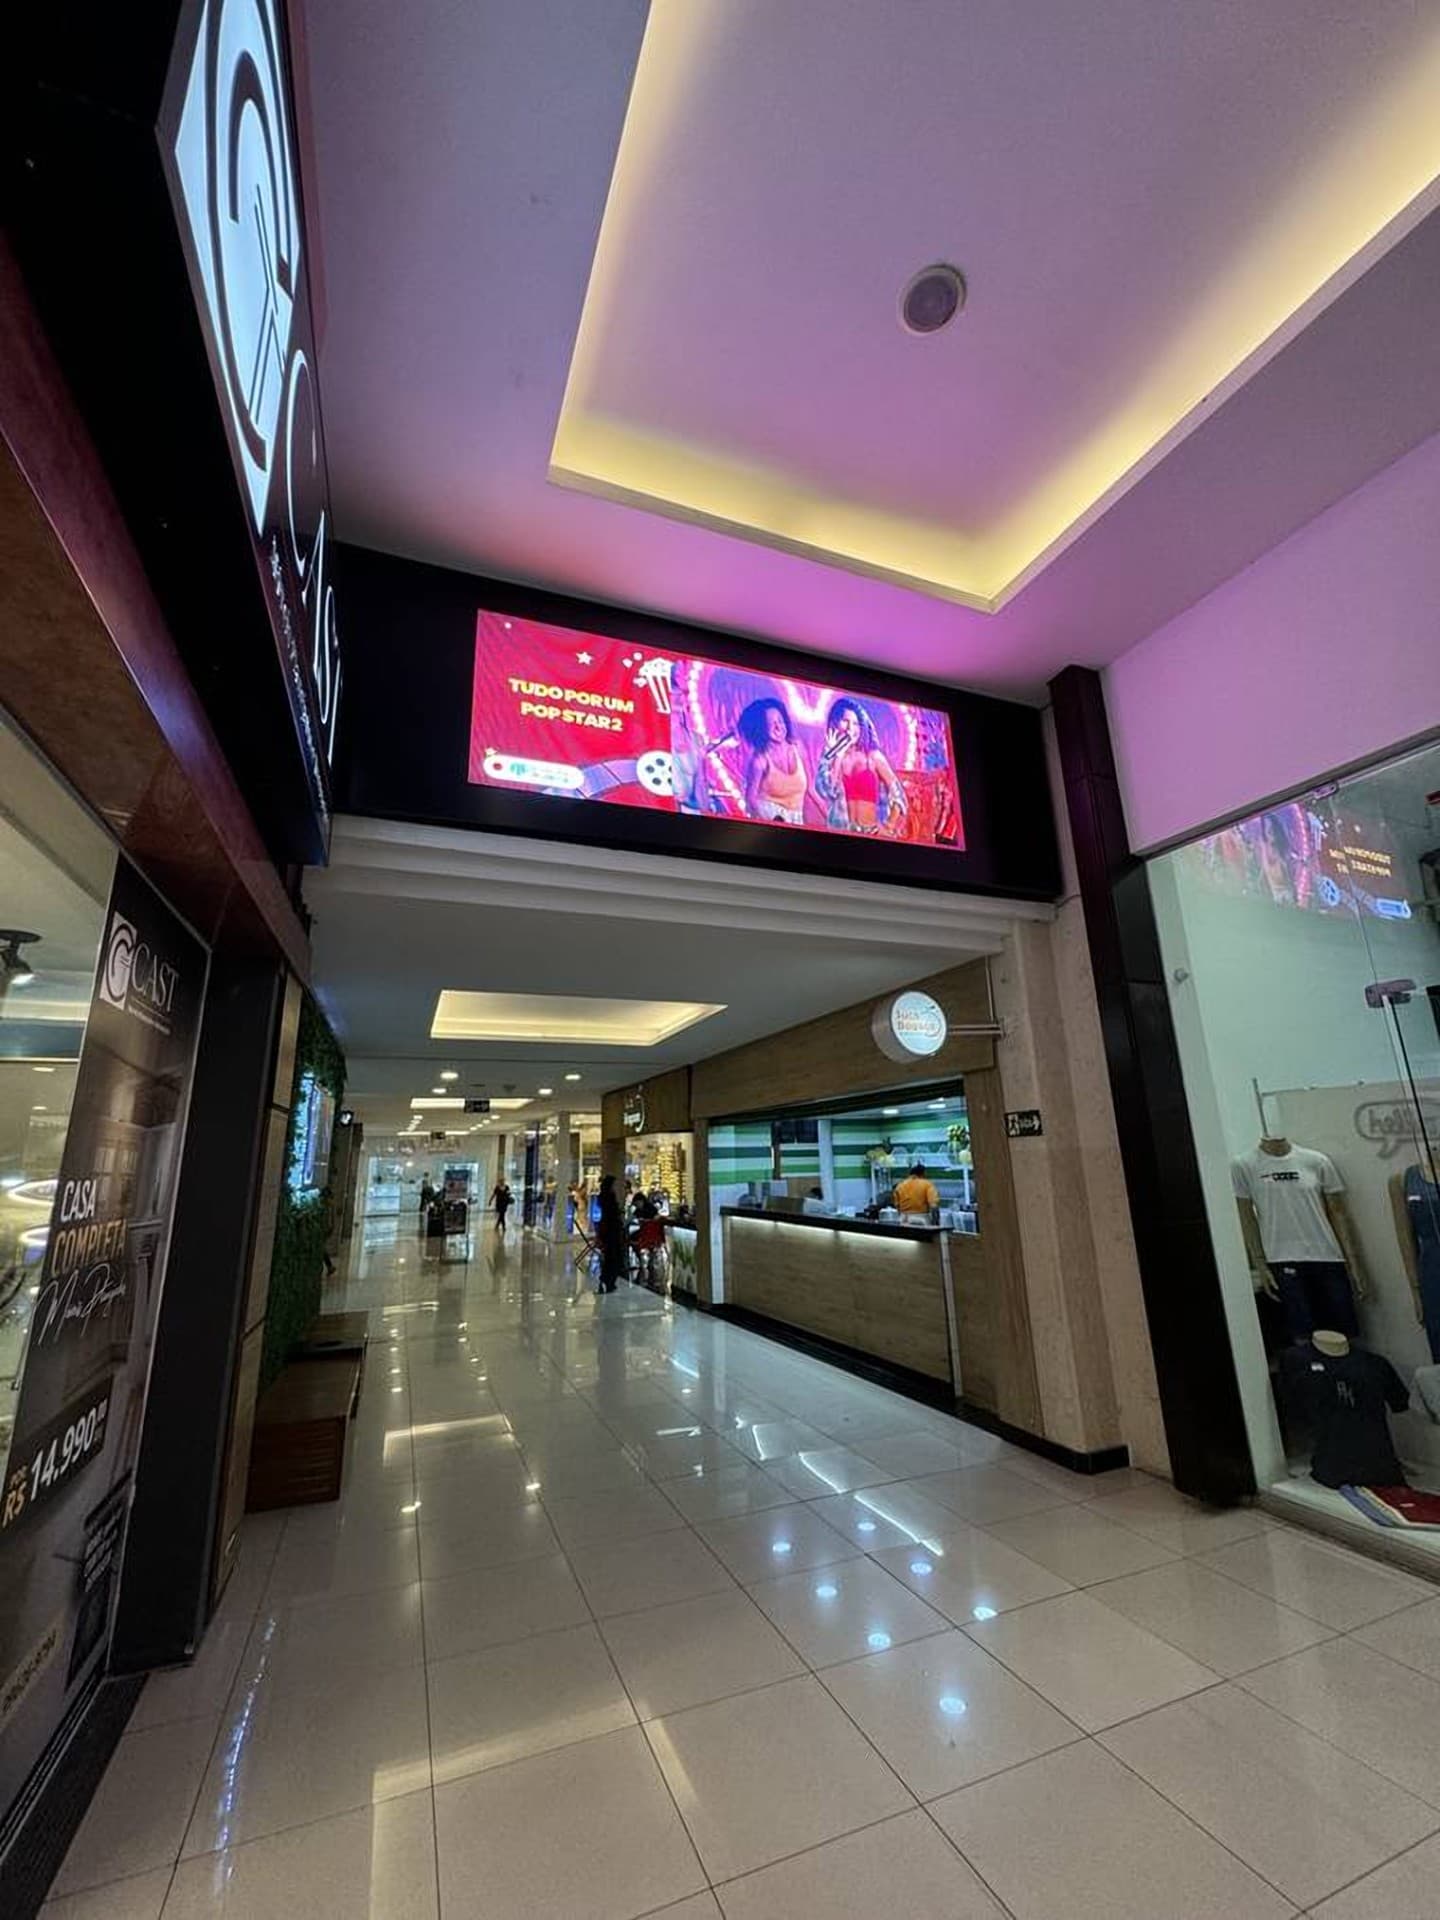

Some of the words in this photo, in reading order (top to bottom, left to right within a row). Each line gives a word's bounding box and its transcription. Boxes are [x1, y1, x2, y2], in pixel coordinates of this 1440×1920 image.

[508, 677, 564, 701] TUDO
[563, 688, 605, 709] POR
[603, 697, 635, 714] UM
[520, 701, 562, 720] POP
[561, 709, 612, 731] STAR
[610, 717, 624, 732] 2
[60, 1178, 97, 1222] CASA
[51, 1218, 128, 1280] COMPLETA
